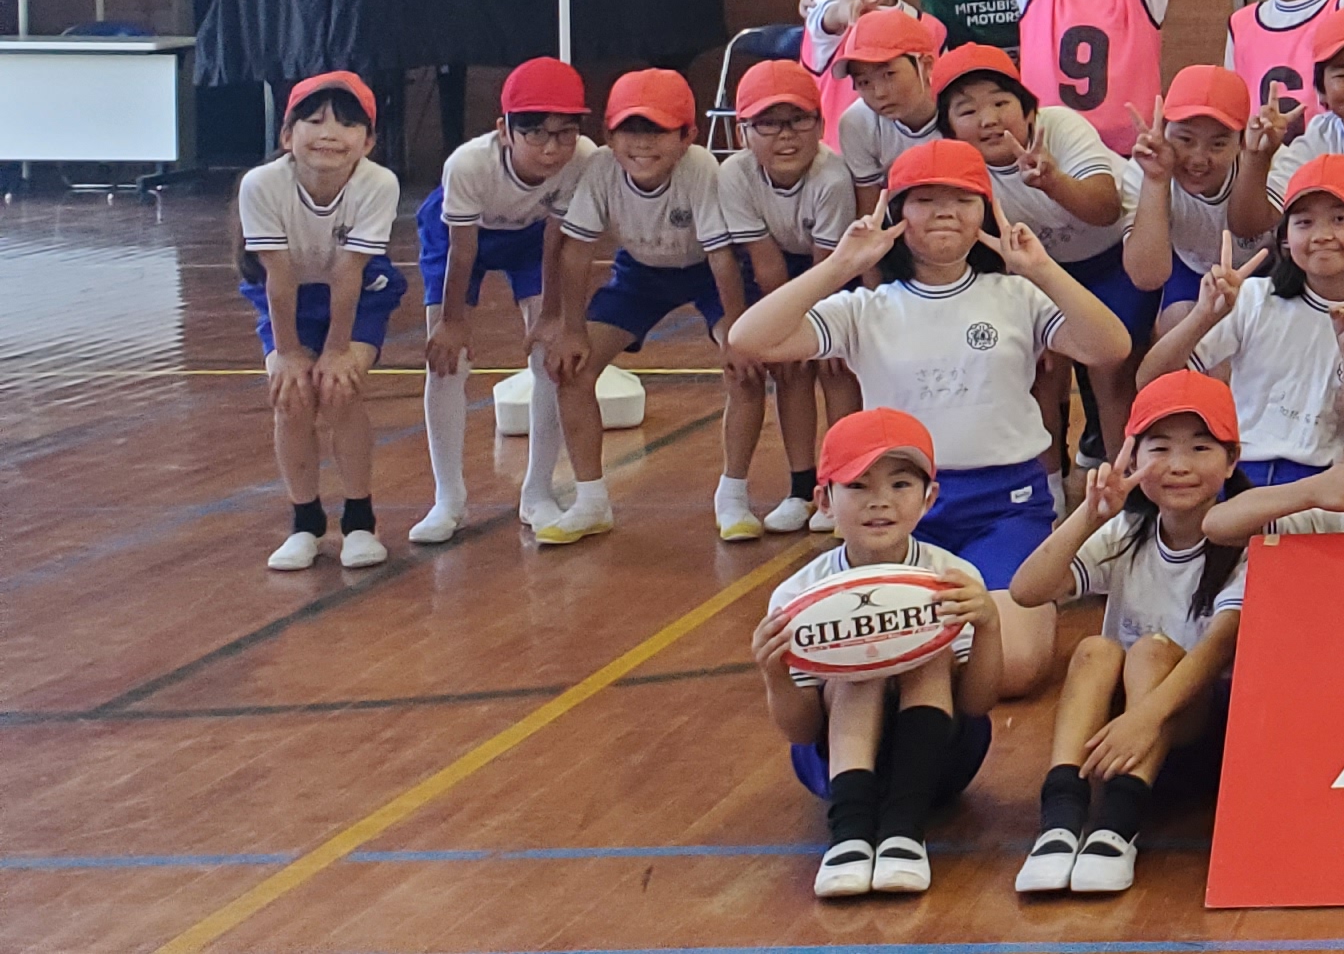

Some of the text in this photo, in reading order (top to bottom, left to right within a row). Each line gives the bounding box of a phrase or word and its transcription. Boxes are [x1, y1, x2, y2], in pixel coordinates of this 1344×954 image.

[955, 0, 1019, 16] MITSUBIS
[1059, 25, 1109, 111] 9
[794, 602, 942, 648] GILBERT
